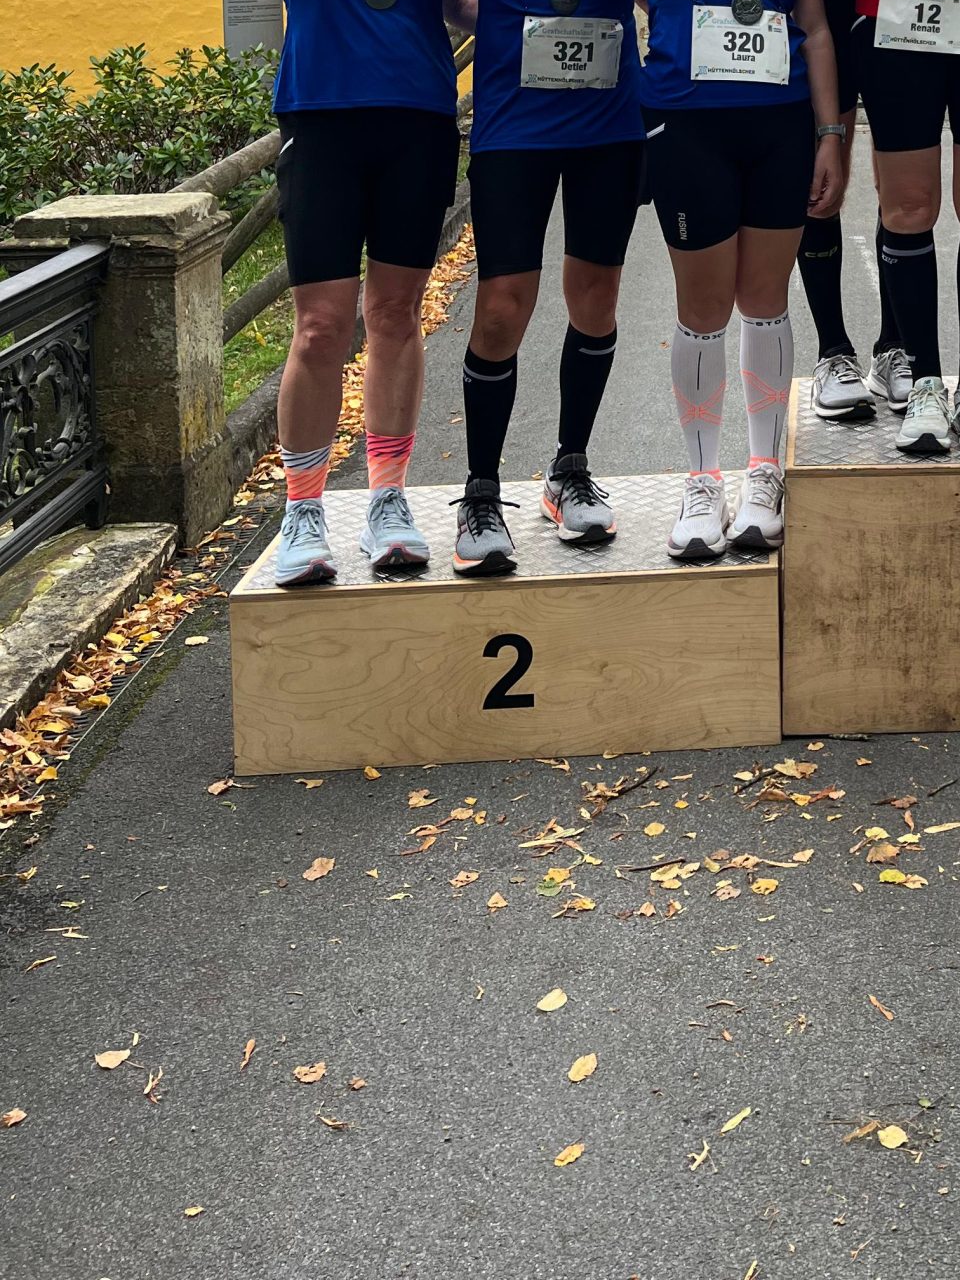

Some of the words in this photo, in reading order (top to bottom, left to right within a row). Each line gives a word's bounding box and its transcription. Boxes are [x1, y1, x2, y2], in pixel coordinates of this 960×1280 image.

[914, 3, 942, 25] 12
[910, 23, 941, 34] Renate
[553, 41, 594, 62] 321
[723, 31, 765, 54] 320
[561, 62, 588, 71] Detlef
[731, 52, 756, 62] Laura
[677, 212, 688, 240] FUSION
[804, 245, 838, 258] cep
[482, 633, 535, 709] 2
